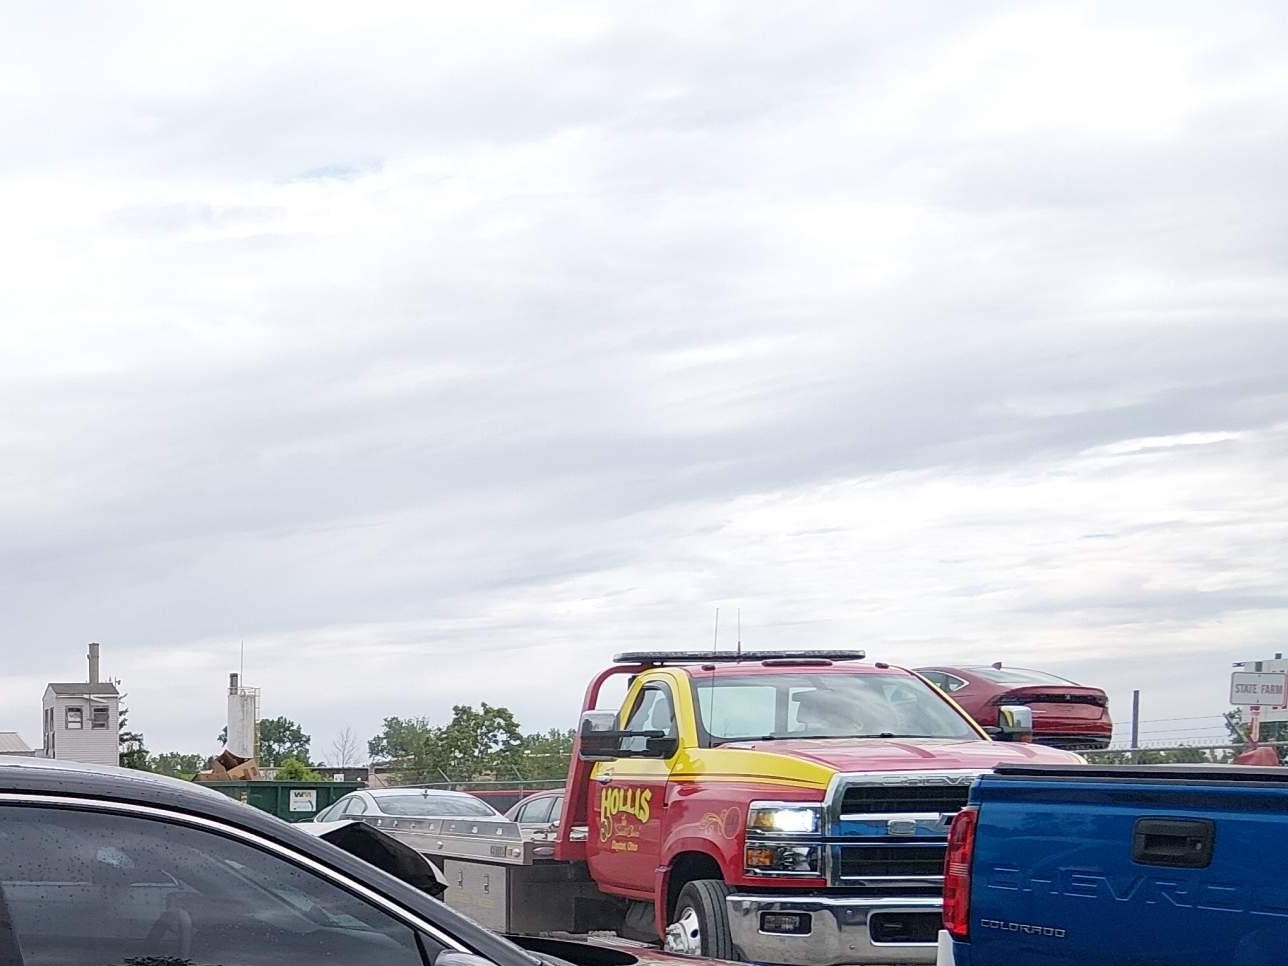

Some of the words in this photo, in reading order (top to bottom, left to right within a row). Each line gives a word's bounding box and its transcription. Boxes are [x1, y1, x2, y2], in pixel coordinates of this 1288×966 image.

[1235, 683, 1257, 694] STATE
[1261, 684, 1283, 695] FARM
[600, 787, 652, 823] HOLLIS
[980, 918, 1066, 938] COLORADO
